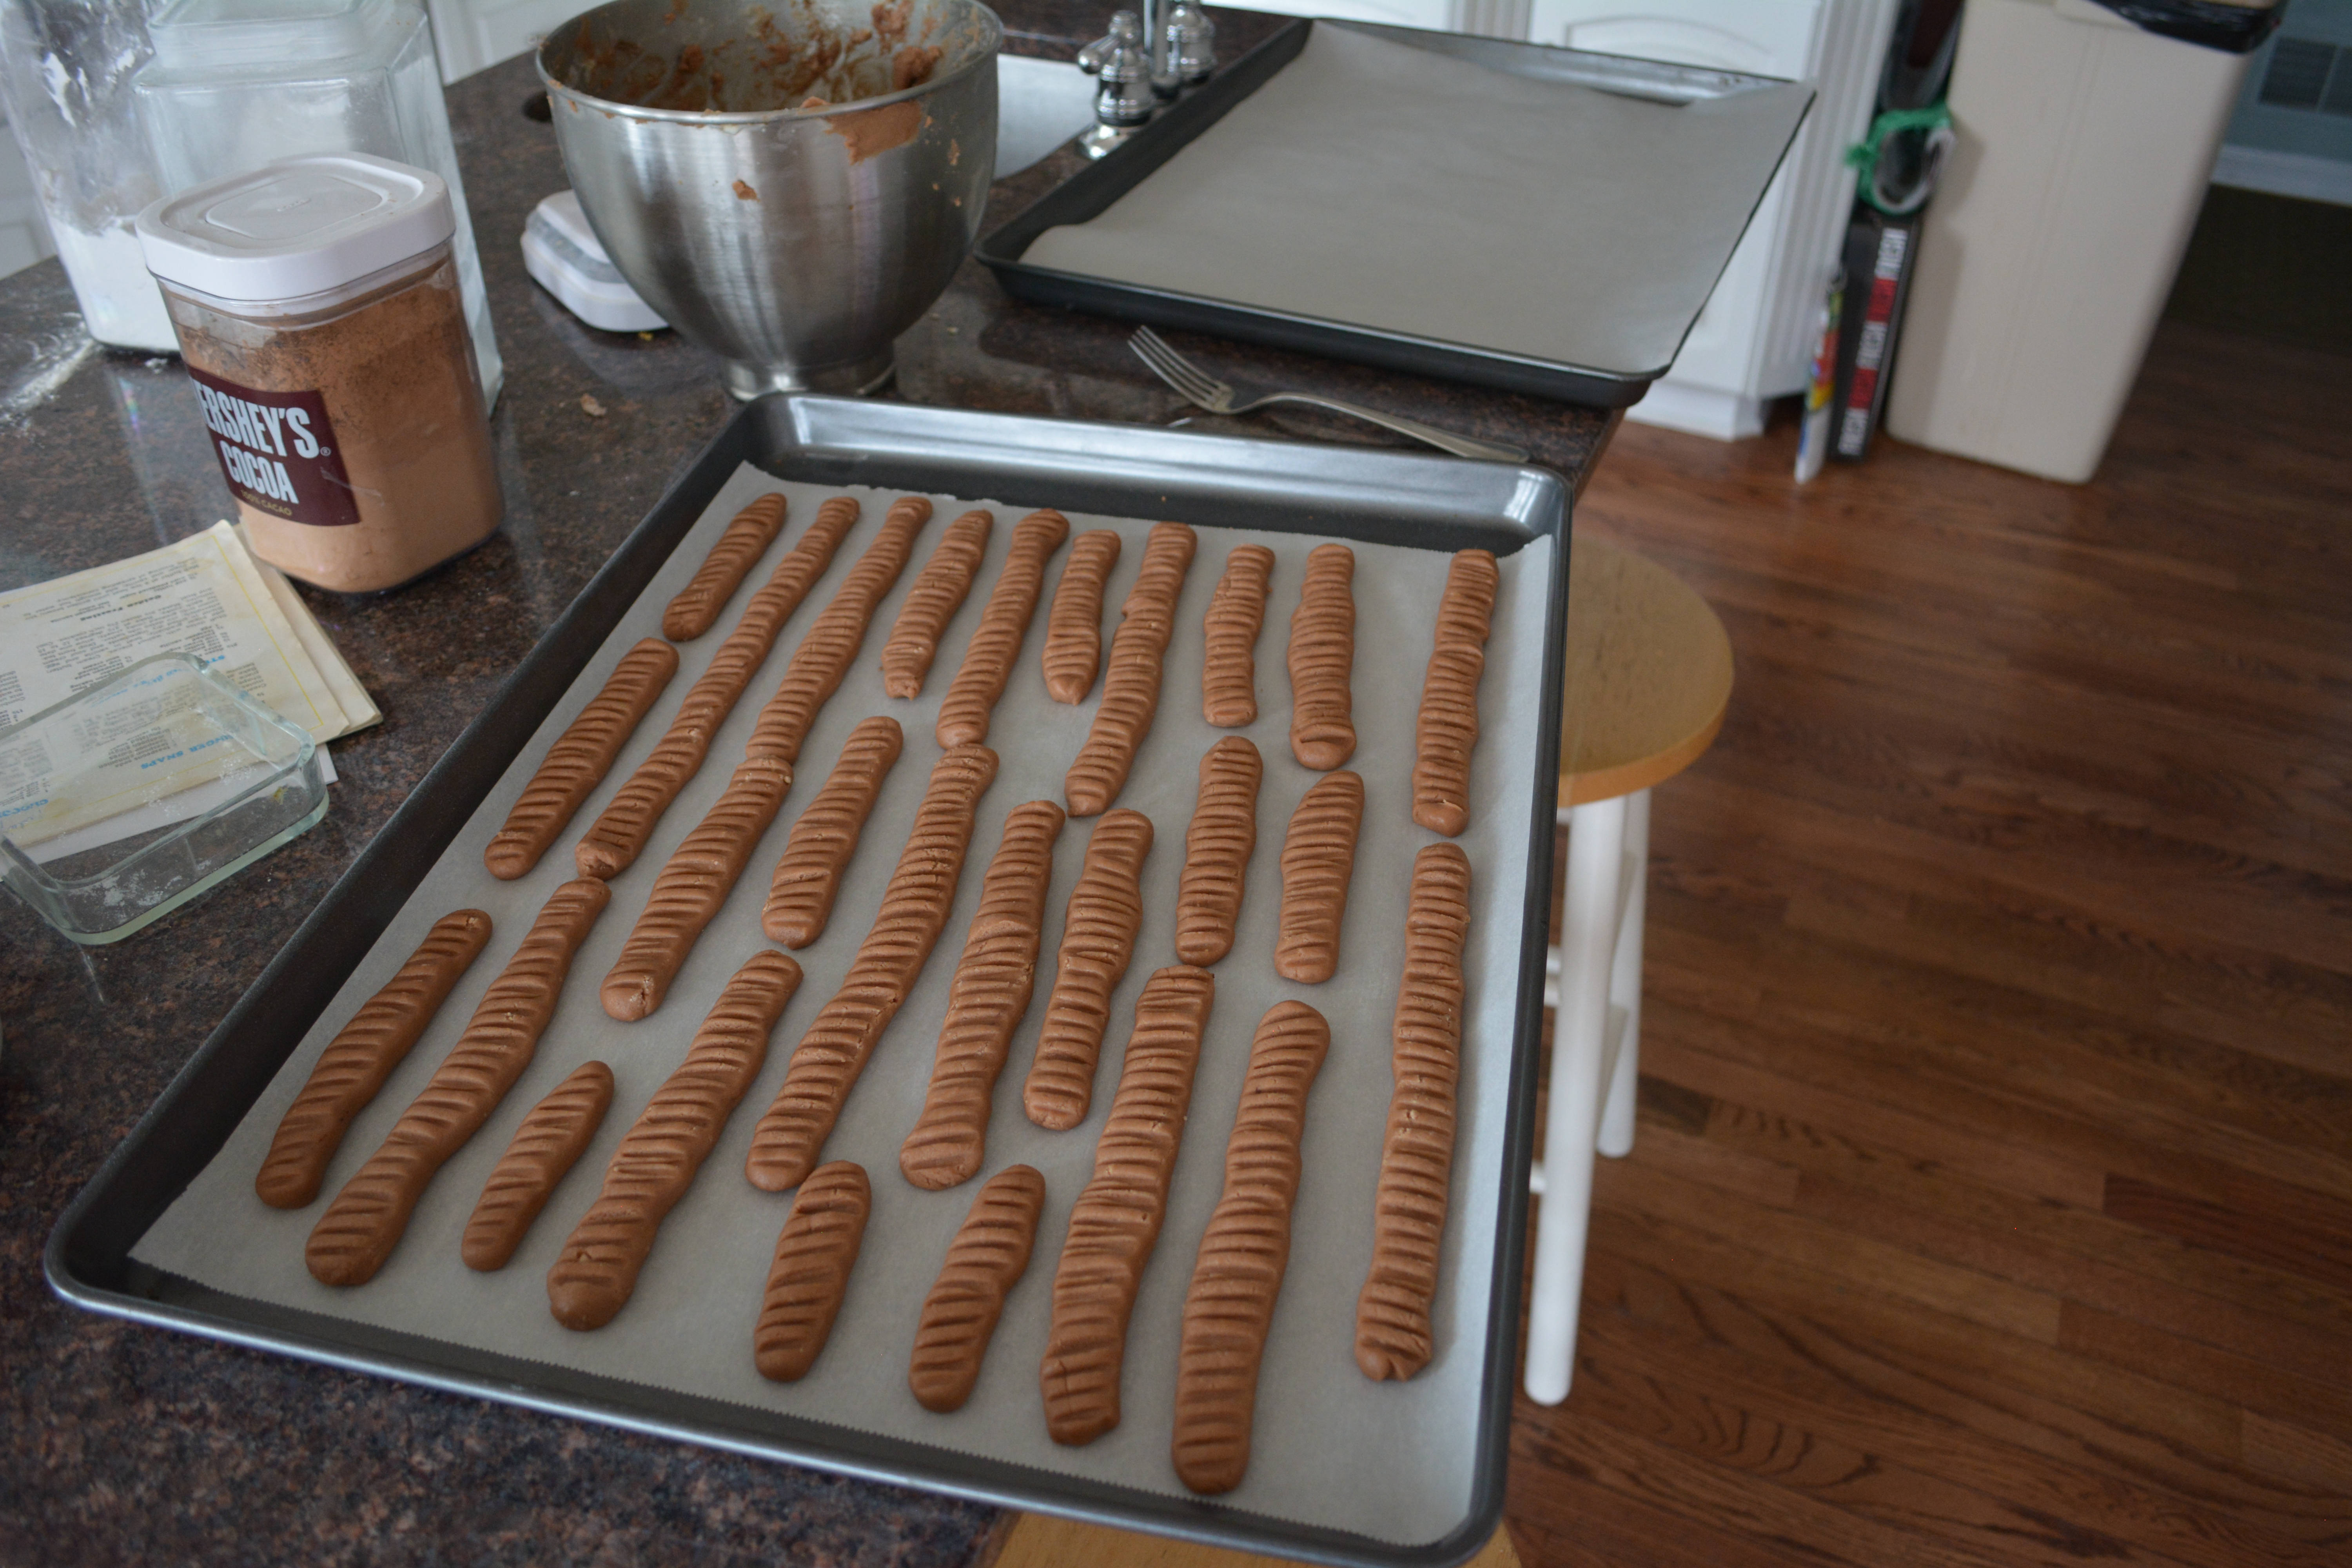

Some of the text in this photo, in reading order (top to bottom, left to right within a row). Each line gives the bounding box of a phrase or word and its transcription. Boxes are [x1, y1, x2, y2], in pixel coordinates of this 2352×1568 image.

[220, 440, 299, 504] COCOA
[261, 499, 293, 516] CACAO
[139, 750, 184, 769] SNAPS
